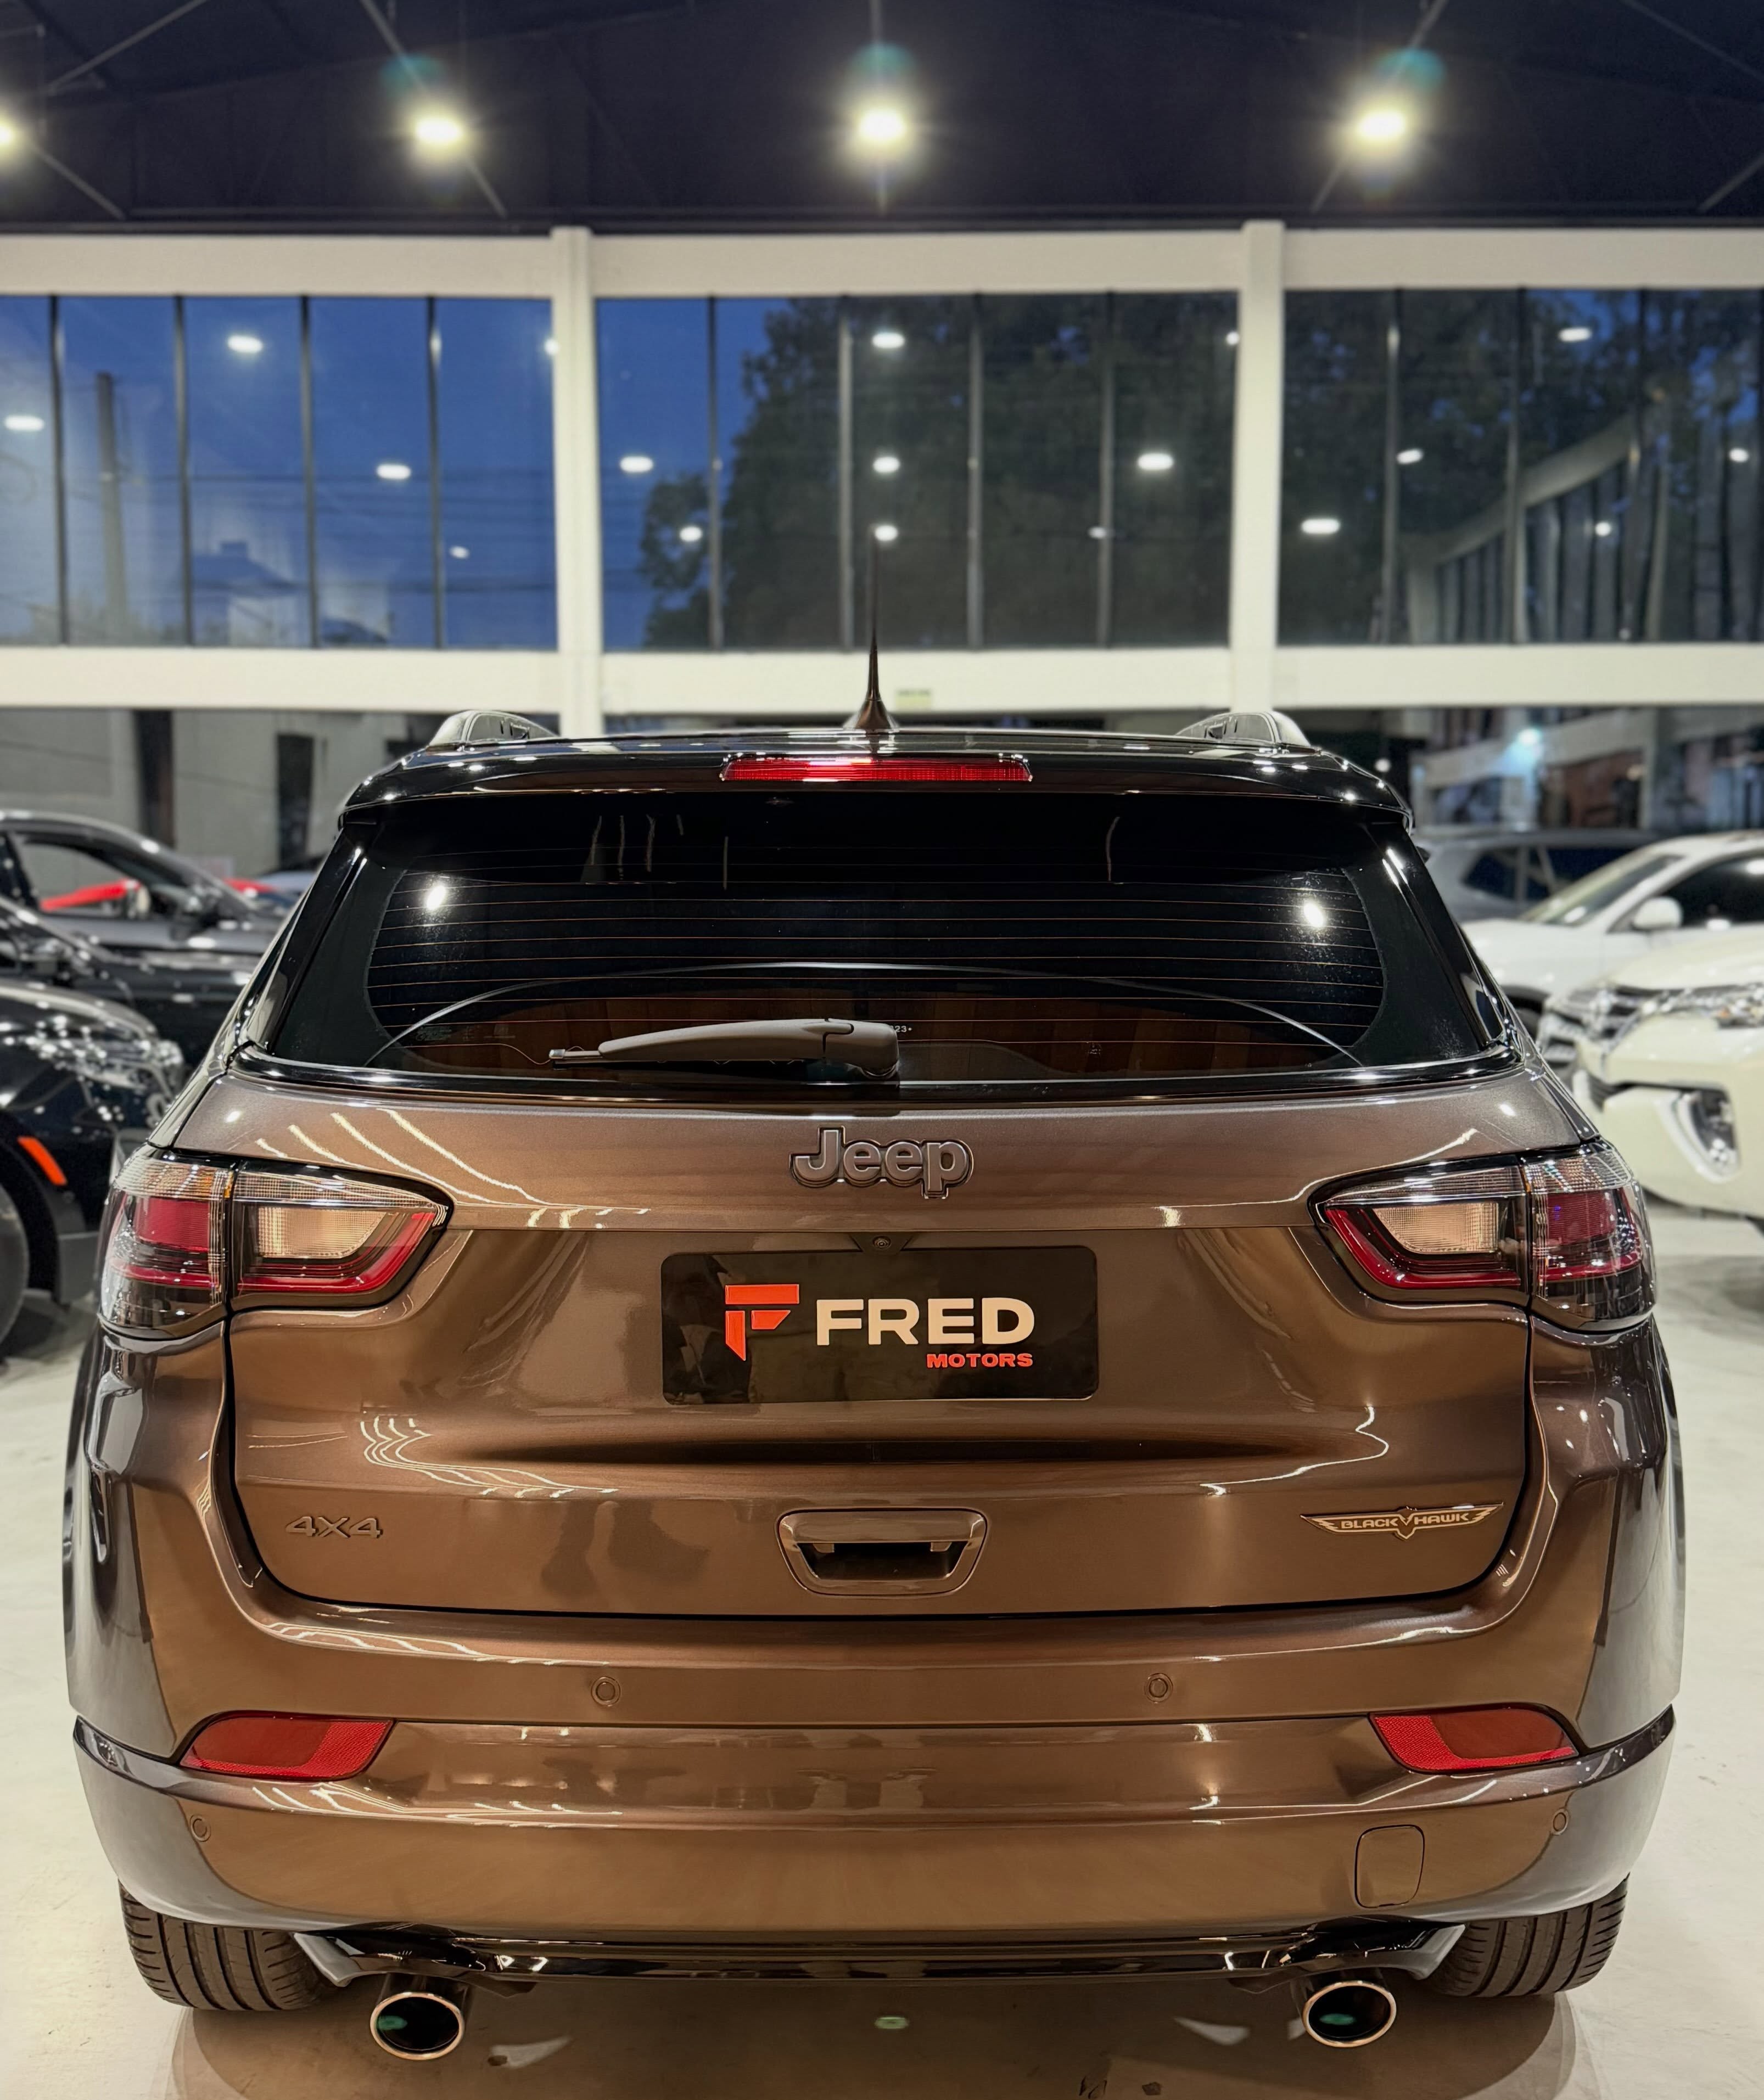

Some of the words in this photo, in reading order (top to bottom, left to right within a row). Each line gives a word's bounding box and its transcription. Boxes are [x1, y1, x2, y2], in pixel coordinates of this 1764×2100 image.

[789, 1125, 975, 1199] Jeep
[816, 1297, 1035, 1346] FRED
[926, 1352, 1034, 1368] MOTORS
[1340, 1517, 1398, 1530] BLACK
[1414, 1512, 1470, 1526] HAWK
